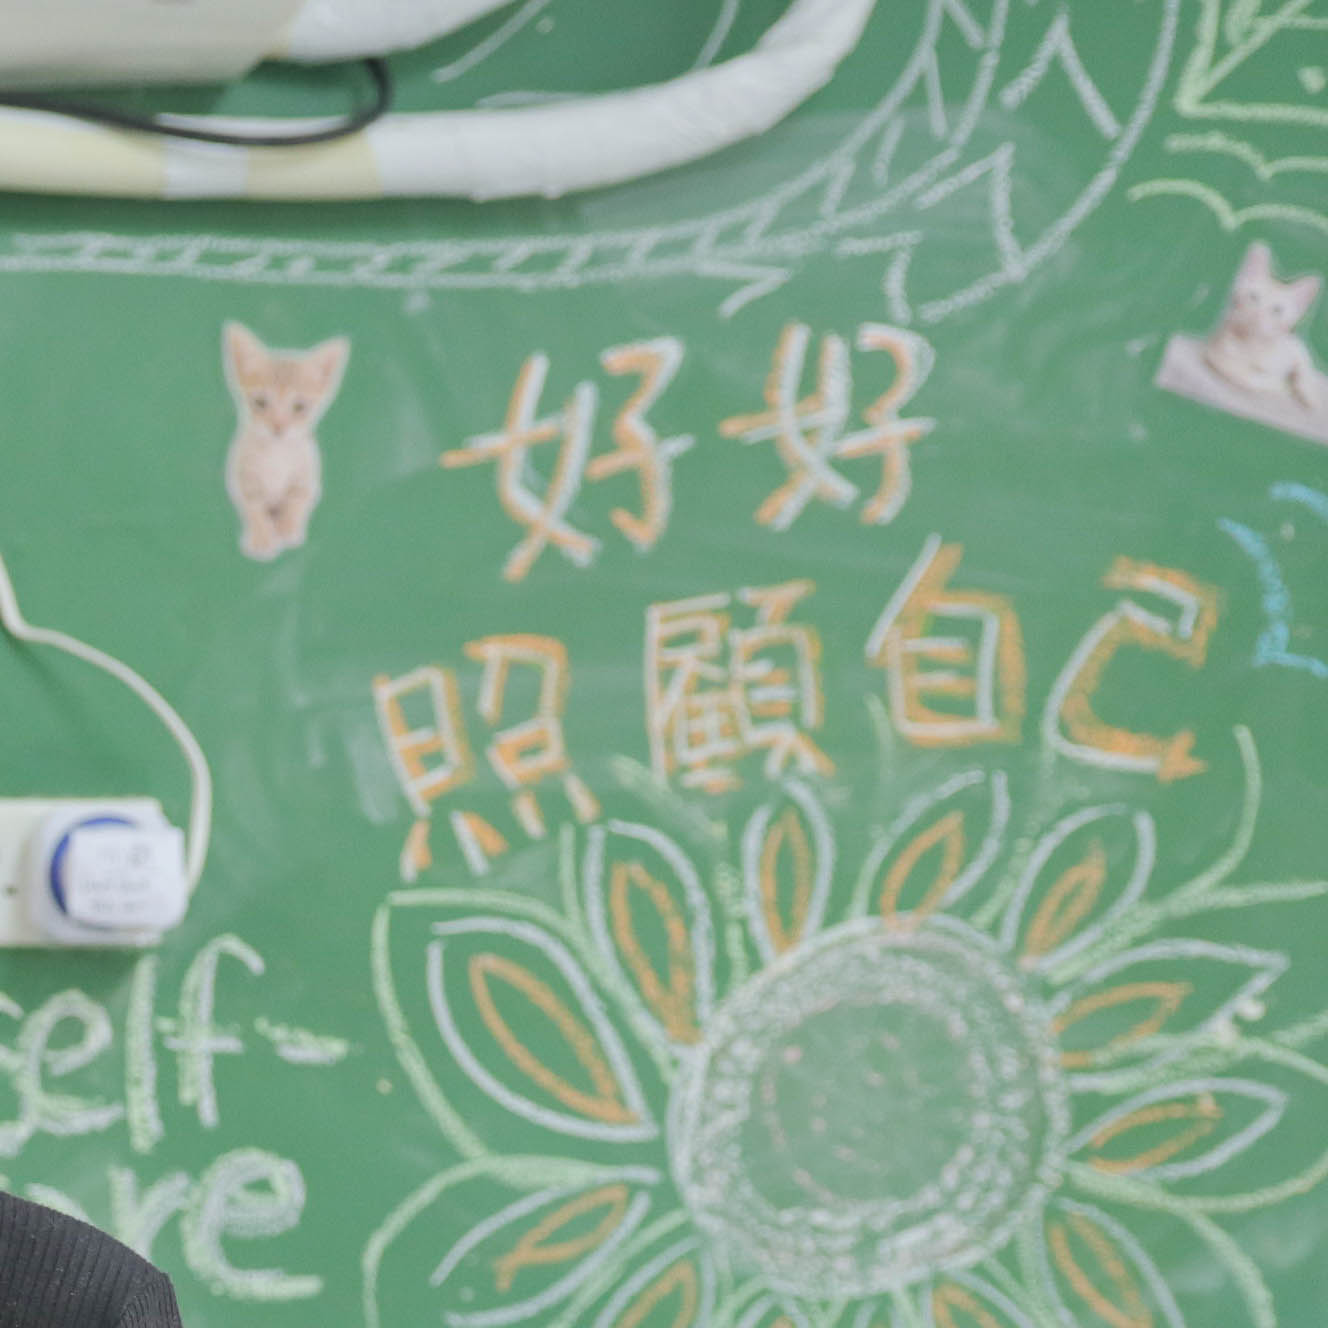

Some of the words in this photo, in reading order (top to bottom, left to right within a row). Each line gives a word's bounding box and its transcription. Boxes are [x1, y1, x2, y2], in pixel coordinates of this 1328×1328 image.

[439, 323, 936, 582] 好好
[372, 533, 1222, 882] 照顧自己
